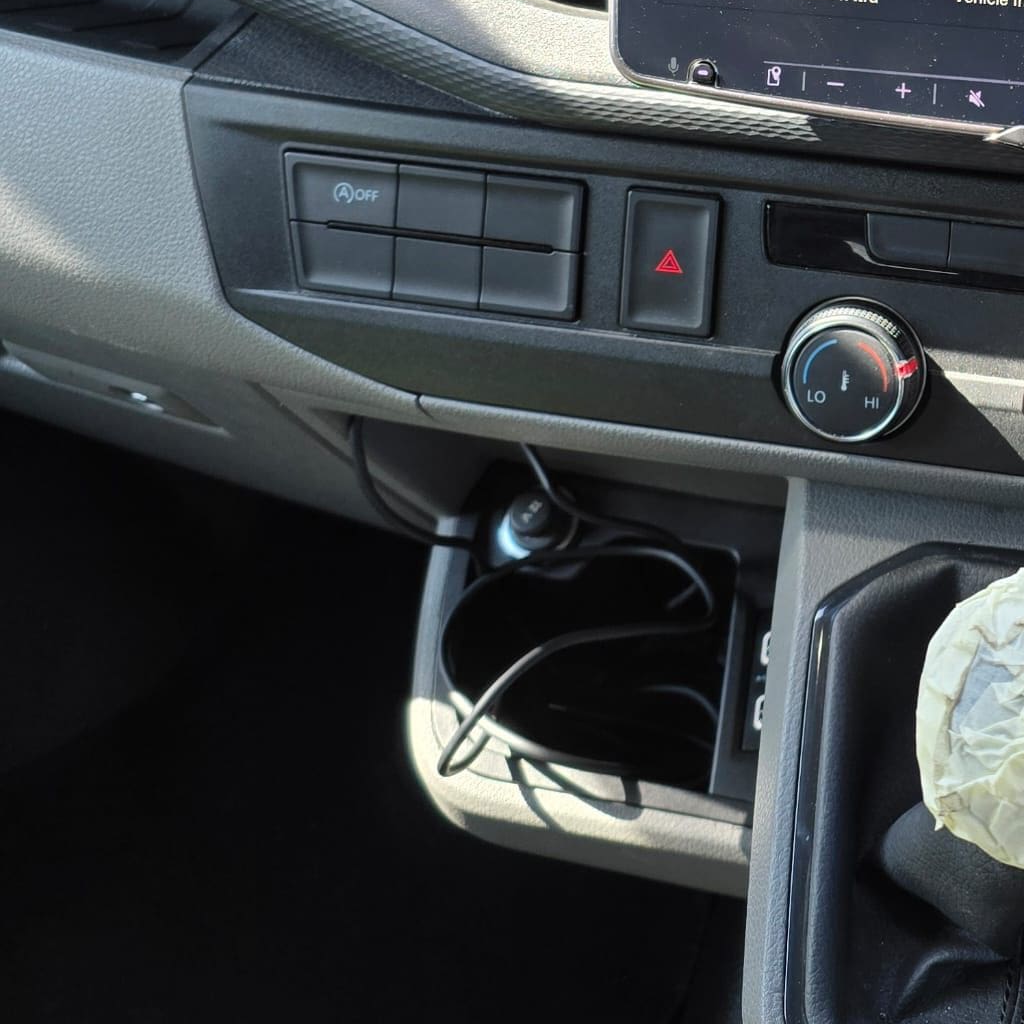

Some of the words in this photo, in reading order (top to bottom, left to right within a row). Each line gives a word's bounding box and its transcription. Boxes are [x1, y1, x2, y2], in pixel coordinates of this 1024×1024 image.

[354, 187, 380, 202] OFF
[806, 389, 826, 404] LO
[864, 395, 879, 410] HI
